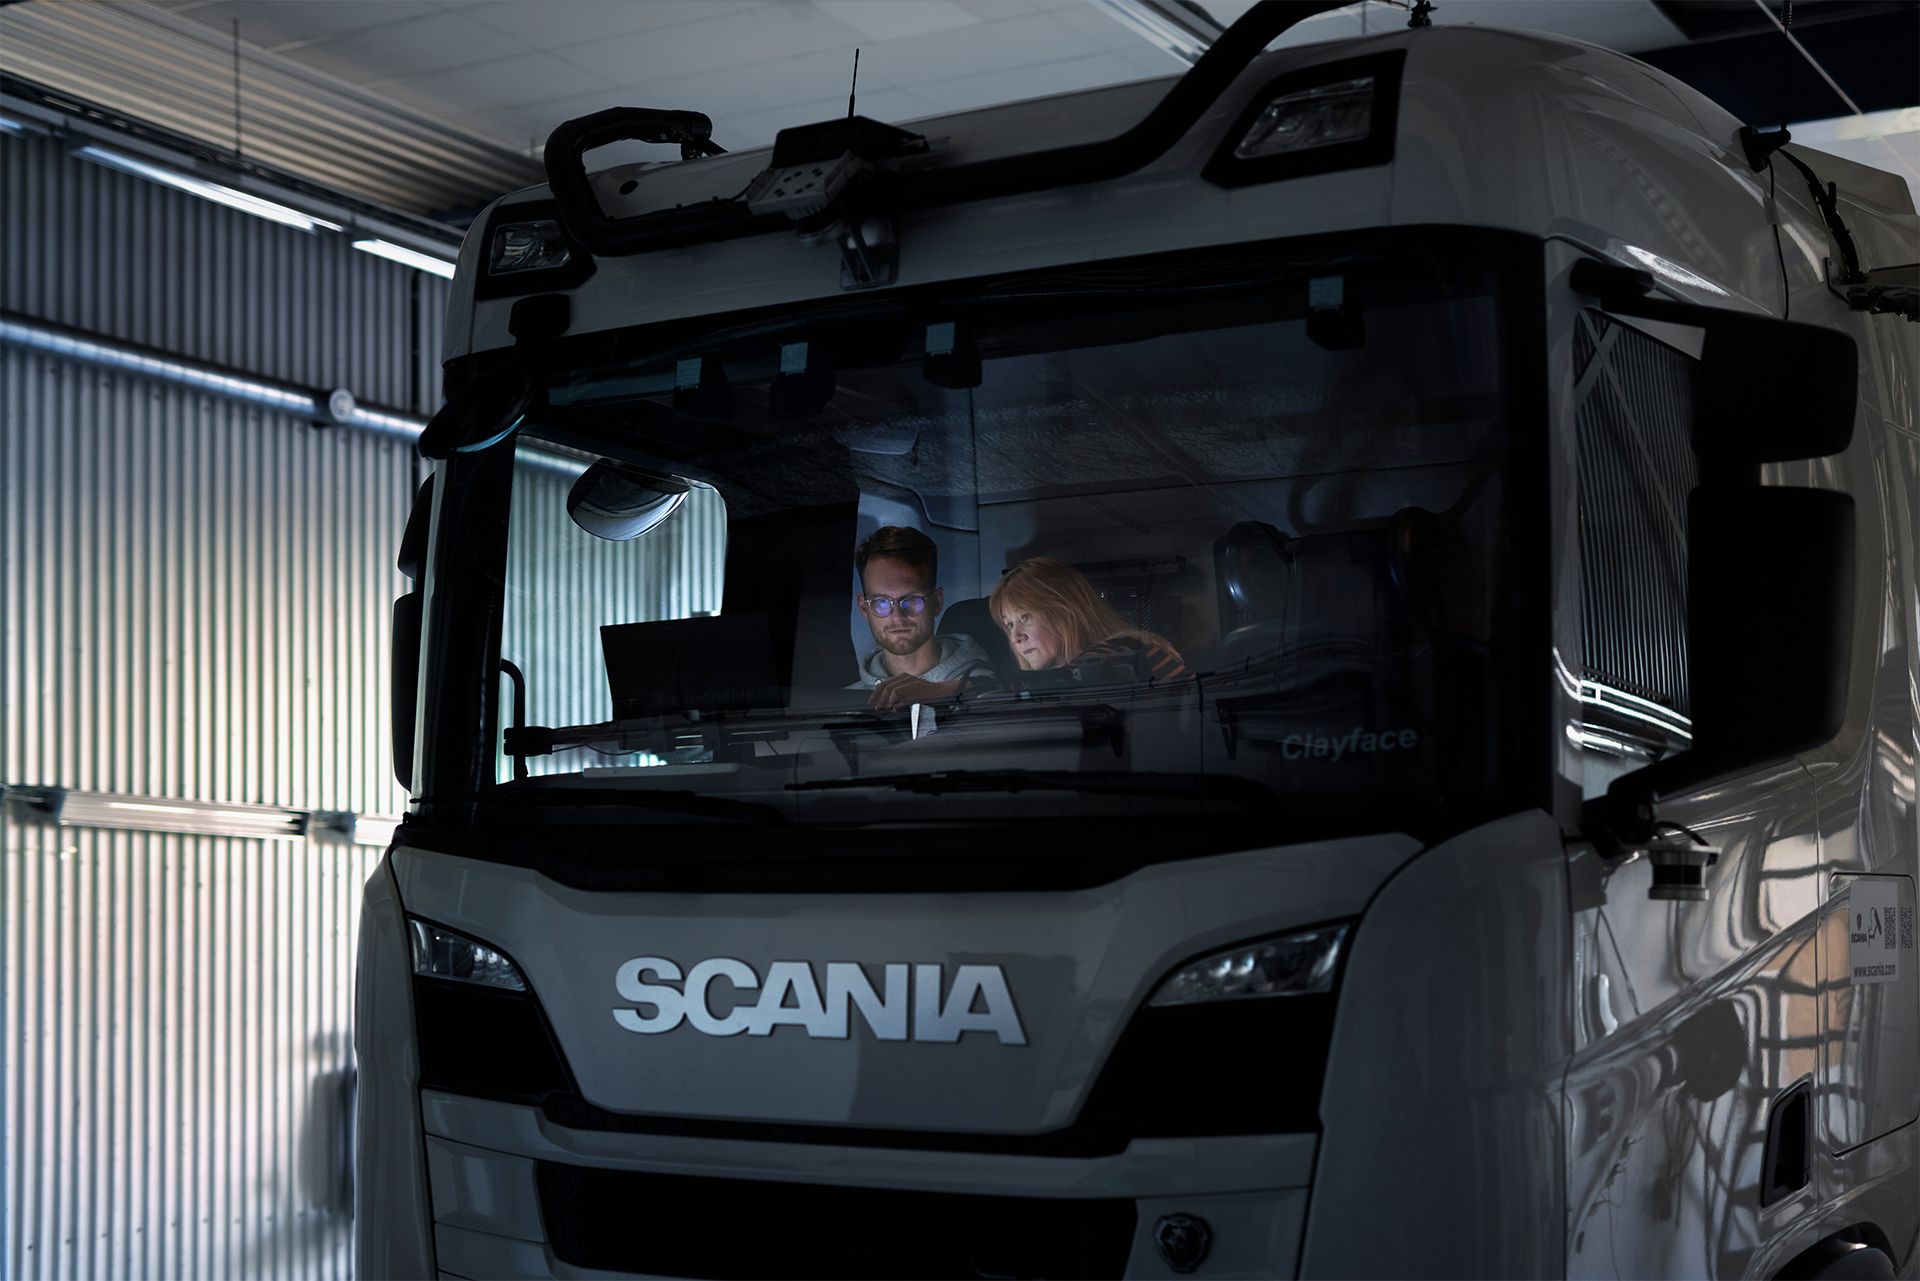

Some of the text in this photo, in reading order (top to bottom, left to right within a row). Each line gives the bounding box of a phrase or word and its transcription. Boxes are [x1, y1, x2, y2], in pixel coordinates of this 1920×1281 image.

[1281, 726, 1418, 762] Clayface
[1851, 933, 1867, 943] SCANIA
[1853, 963, 1896, 977] www.scania.com
[612, 957, 1028, 1046] SCANIA
